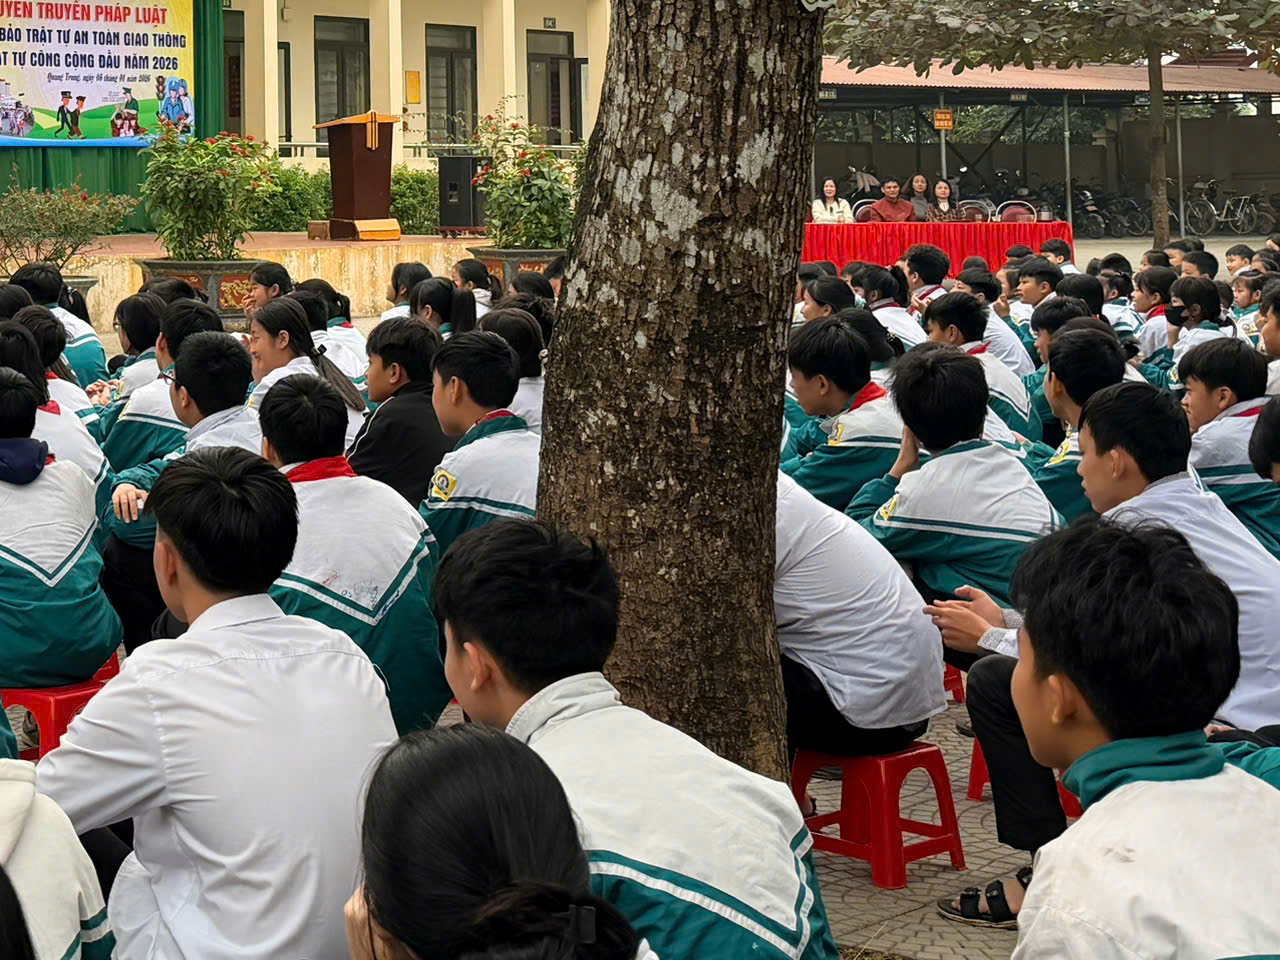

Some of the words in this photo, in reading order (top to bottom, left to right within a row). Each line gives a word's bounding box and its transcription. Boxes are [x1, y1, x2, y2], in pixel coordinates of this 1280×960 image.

[95, 3, 131, 23] PHÁP
[135, 4, 168, 28] LUẬT
[0, 23, 22, 42] BẢO
[26, 26, 53, 46] TRẬT
[56, 28, 70, 47] TỰ
[74, 30, 88, 45] AN
[92, 29, 120, 46] TOÀN
[123, 32, 149, 47] GIAO
[152, 31, 186, 48] THÔNG
[12, 50, 26, 69] TỰ
[30, 50, 60, 67] CÔNG
[64, 51, 94, 71] CỘNG
[98, 49, 120, 69] ĐẦU
[124, 53, 149, 70] NĂM
[152, 56, 178, 70] 2026
